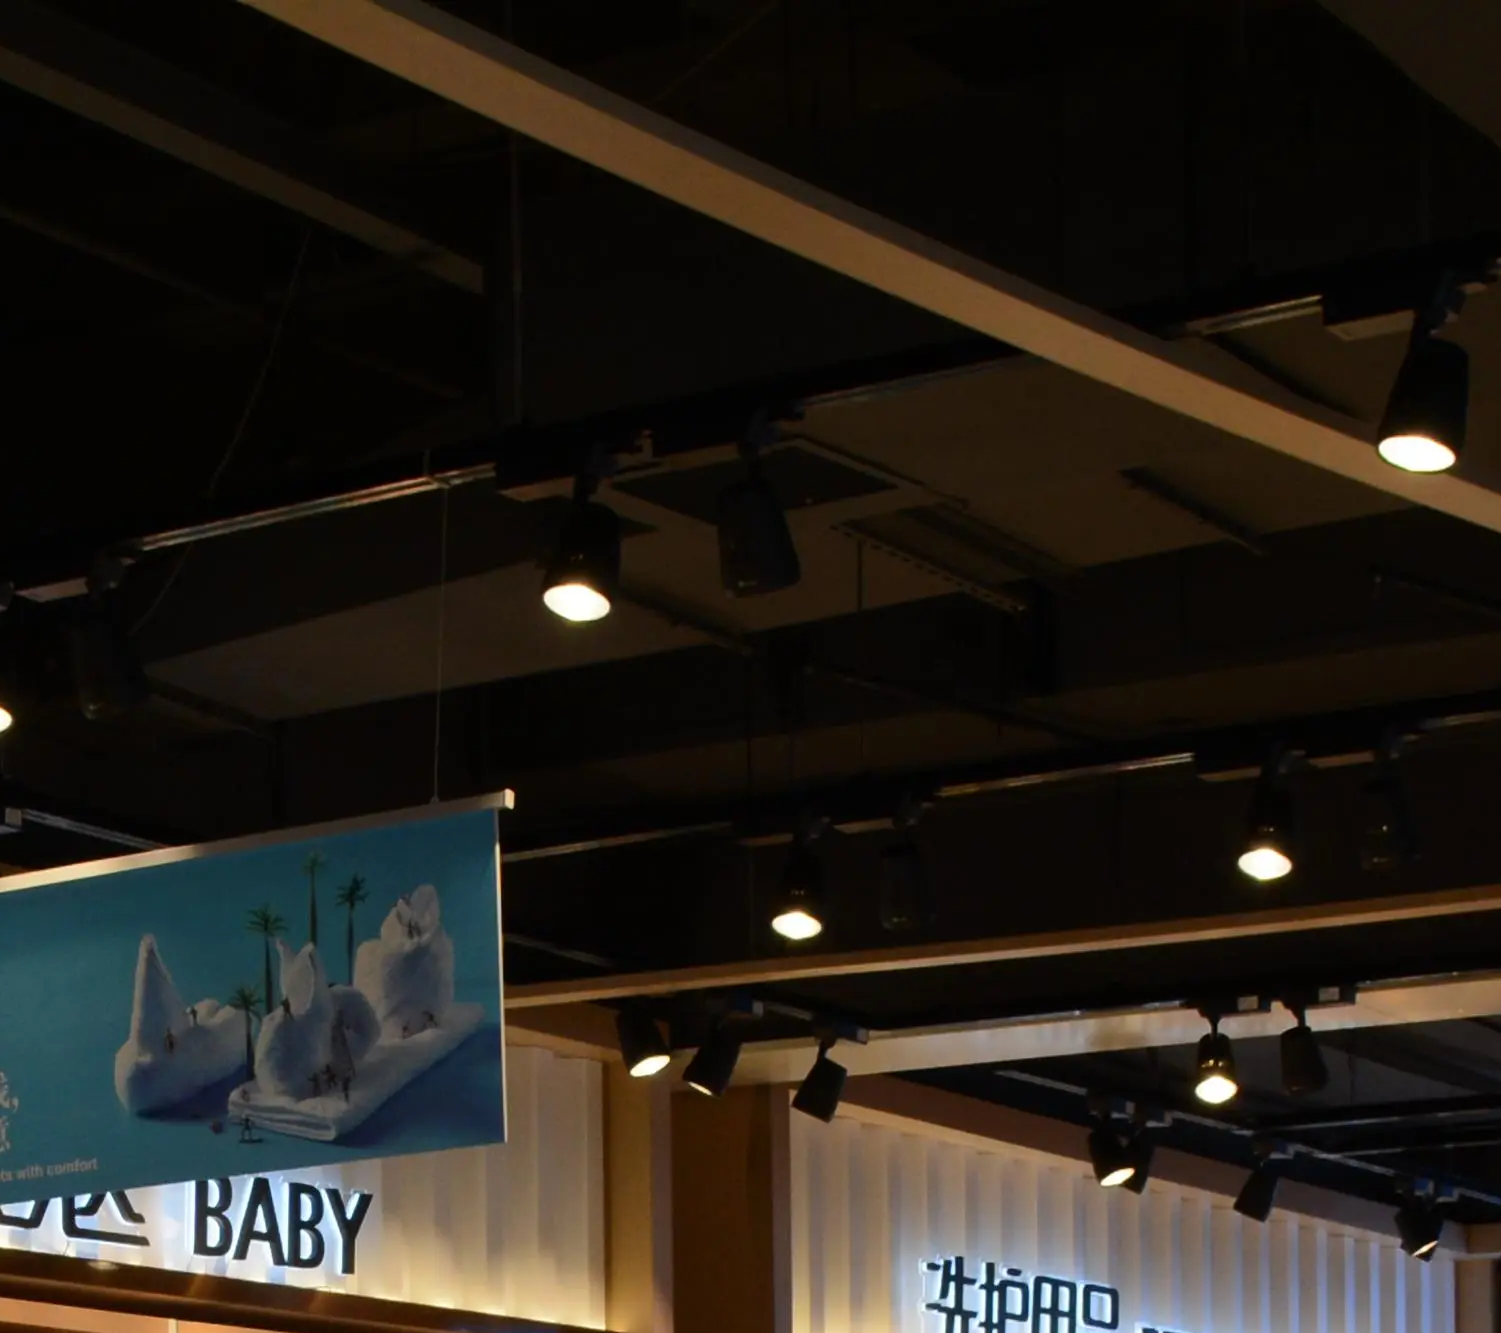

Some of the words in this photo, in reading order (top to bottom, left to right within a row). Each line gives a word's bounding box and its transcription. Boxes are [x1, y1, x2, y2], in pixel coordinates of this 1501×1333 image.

[16, 1164, 44, 1180] with
[47, 1158, 98, 1176] comfort
[193, 1177, 373, 1275] BABY
